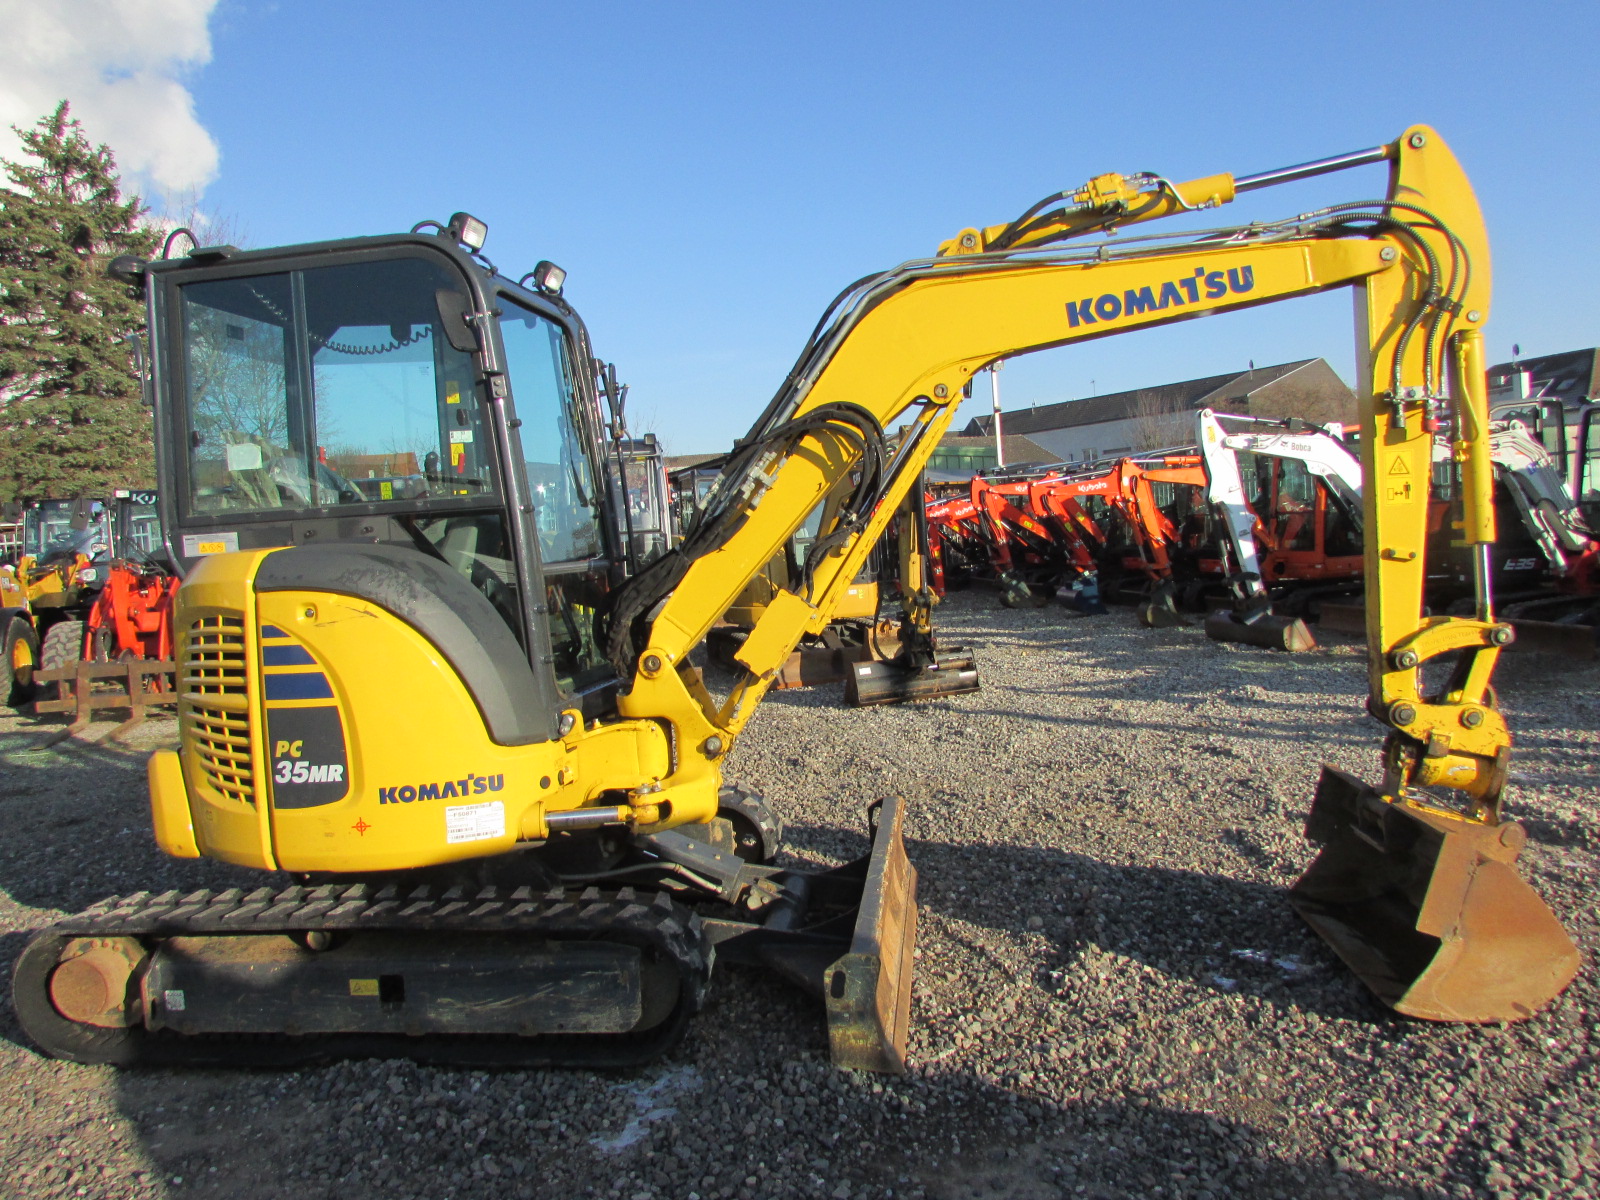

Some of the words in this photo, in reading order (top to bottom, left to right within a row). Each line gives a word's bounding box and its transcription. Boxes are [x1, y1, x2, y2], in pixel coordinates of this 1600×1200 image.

[1065, 265, 1254, 328] KOMATSU
[1078, 482, 1107, 492] Kubota
[132, 492, 158, 505] Ku
[275, 740, 303, 758] PC
[275, 761, 344, 784] 35MR
[379, 773, 504, 805] KOMATSU
